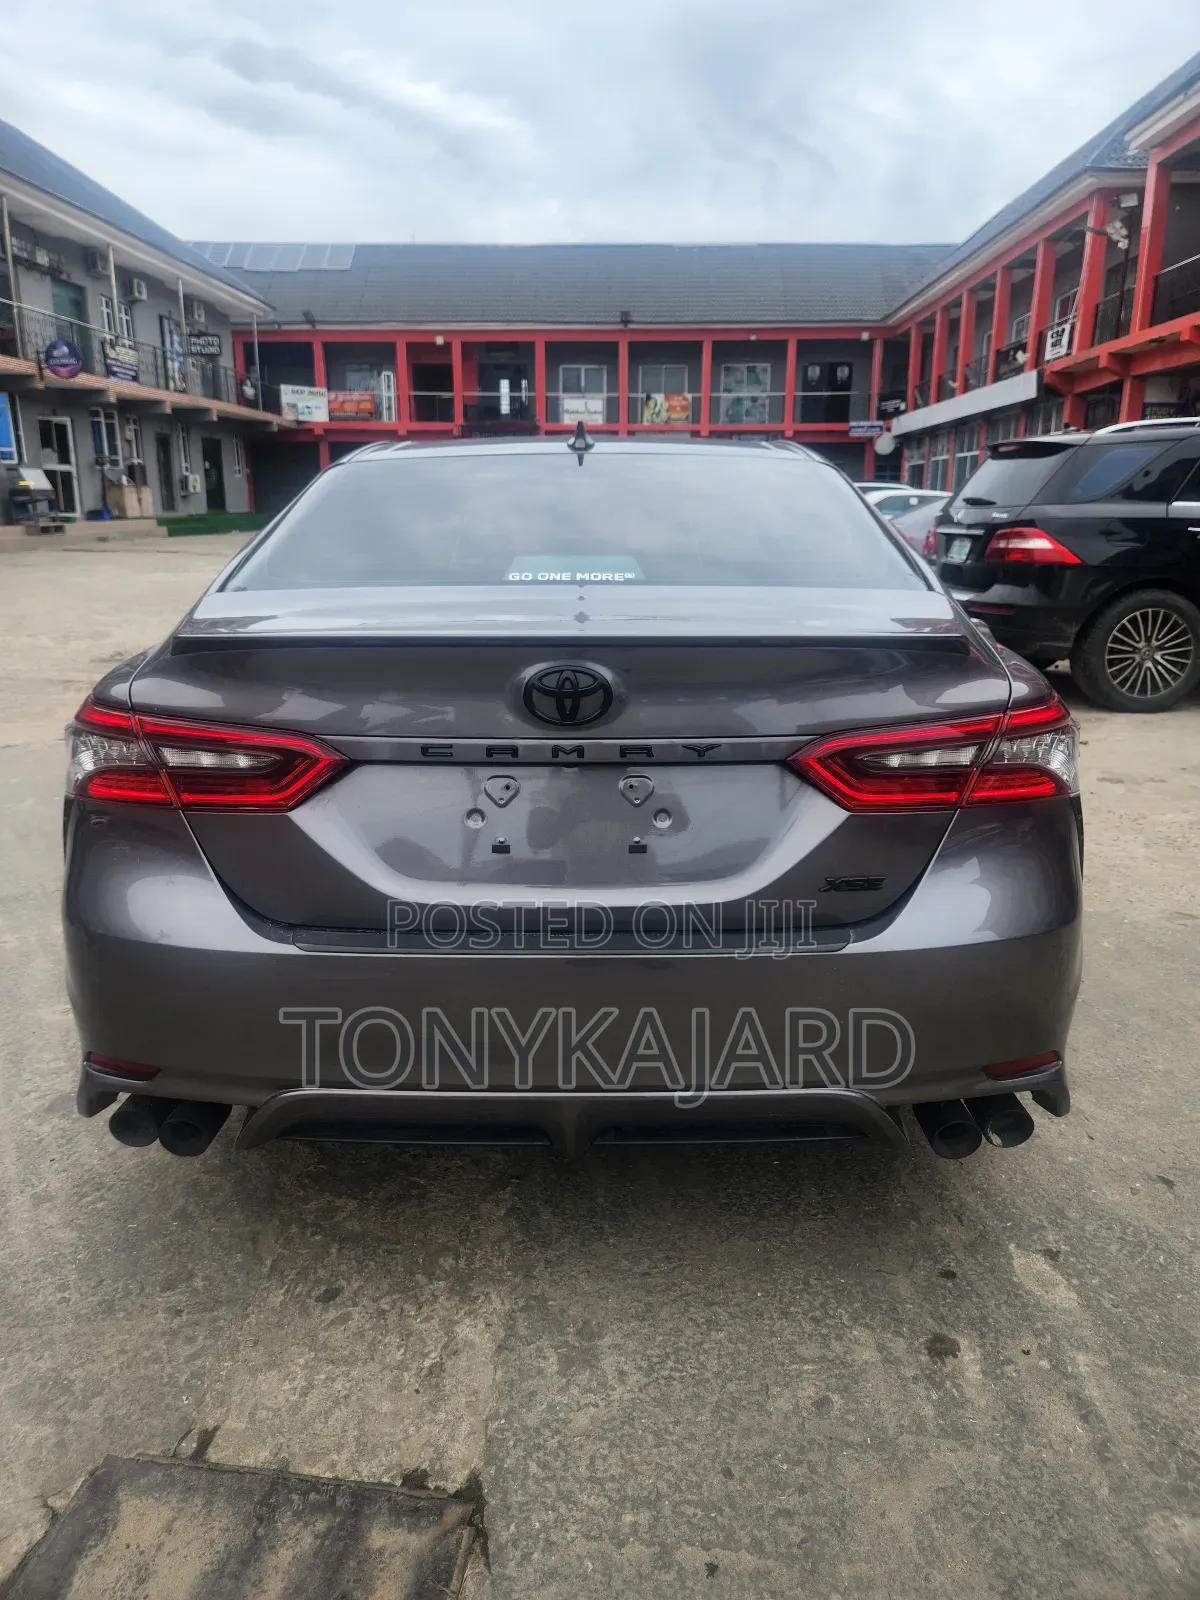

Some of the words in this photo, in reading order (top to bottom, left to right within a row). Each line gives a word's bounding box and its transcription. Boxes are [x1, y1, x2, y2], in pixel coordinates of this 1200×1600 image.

[190, 336, 220, 346] PHOTO
[190, 346, 221, 355] STUDIO
[508, 572, 533, 581] GO
[537, 572, 572, 581] ONE
[420, 744, 723, 759] CAMRY
[818, 875, 887, 892] XSE
